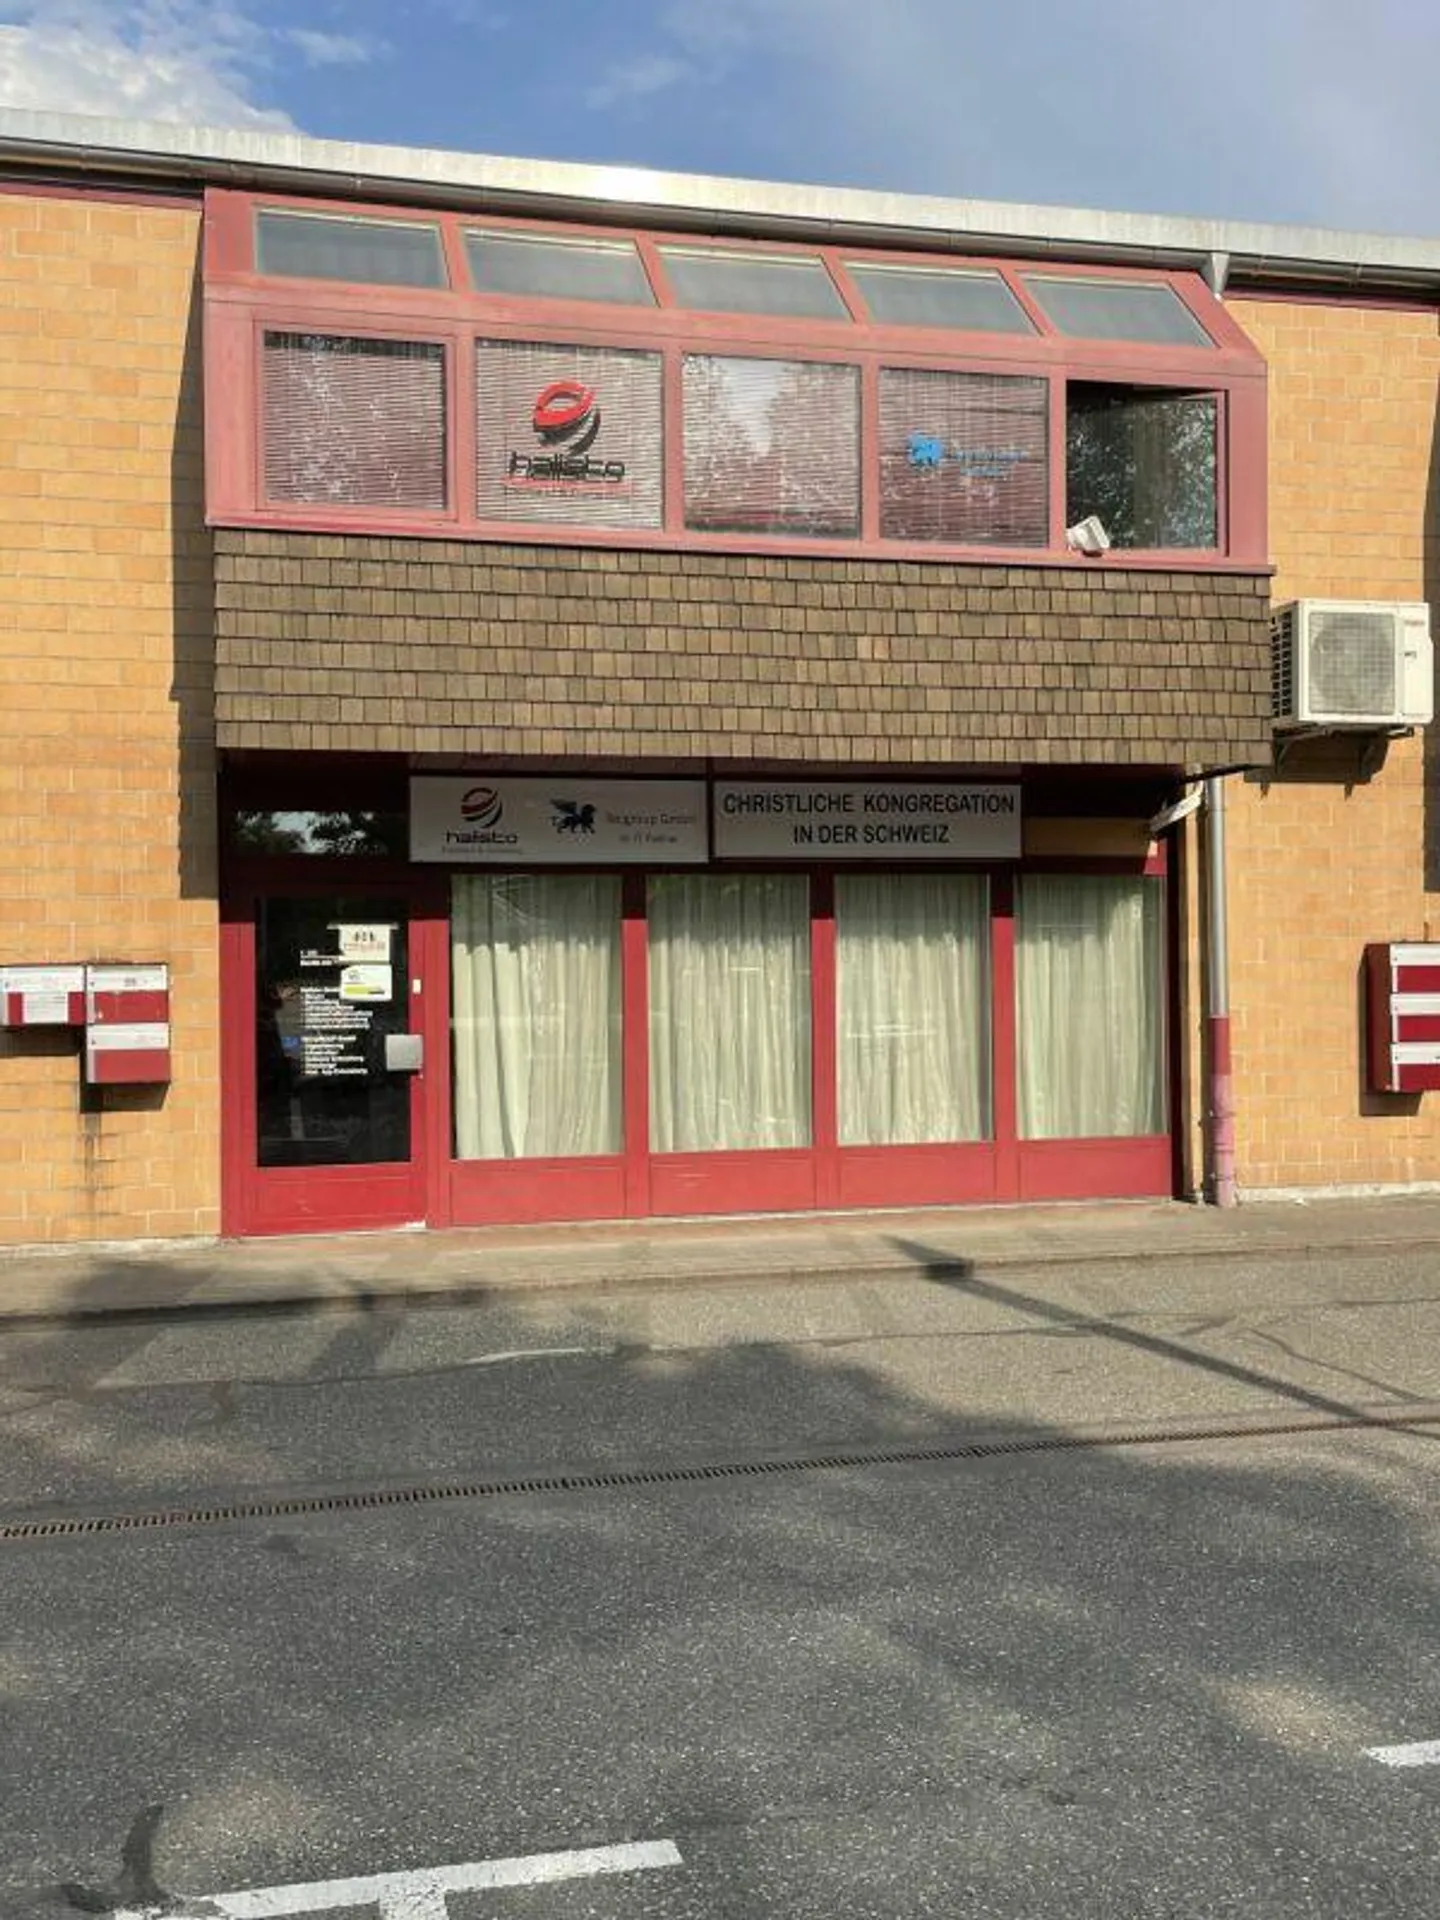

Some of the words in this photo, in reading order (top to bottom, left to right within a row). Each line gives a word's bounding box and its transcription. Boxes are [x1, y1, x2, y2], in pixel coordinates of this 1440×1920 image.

[723, 792, 854, 814] CHRISTLICHE
[864, 793, 1015, 814] KONGREGATION
[794, 825, 813, 844] IN
[818, 825, 857, 844] DER
[863, 824, 950, 844] SCHWEIZ
